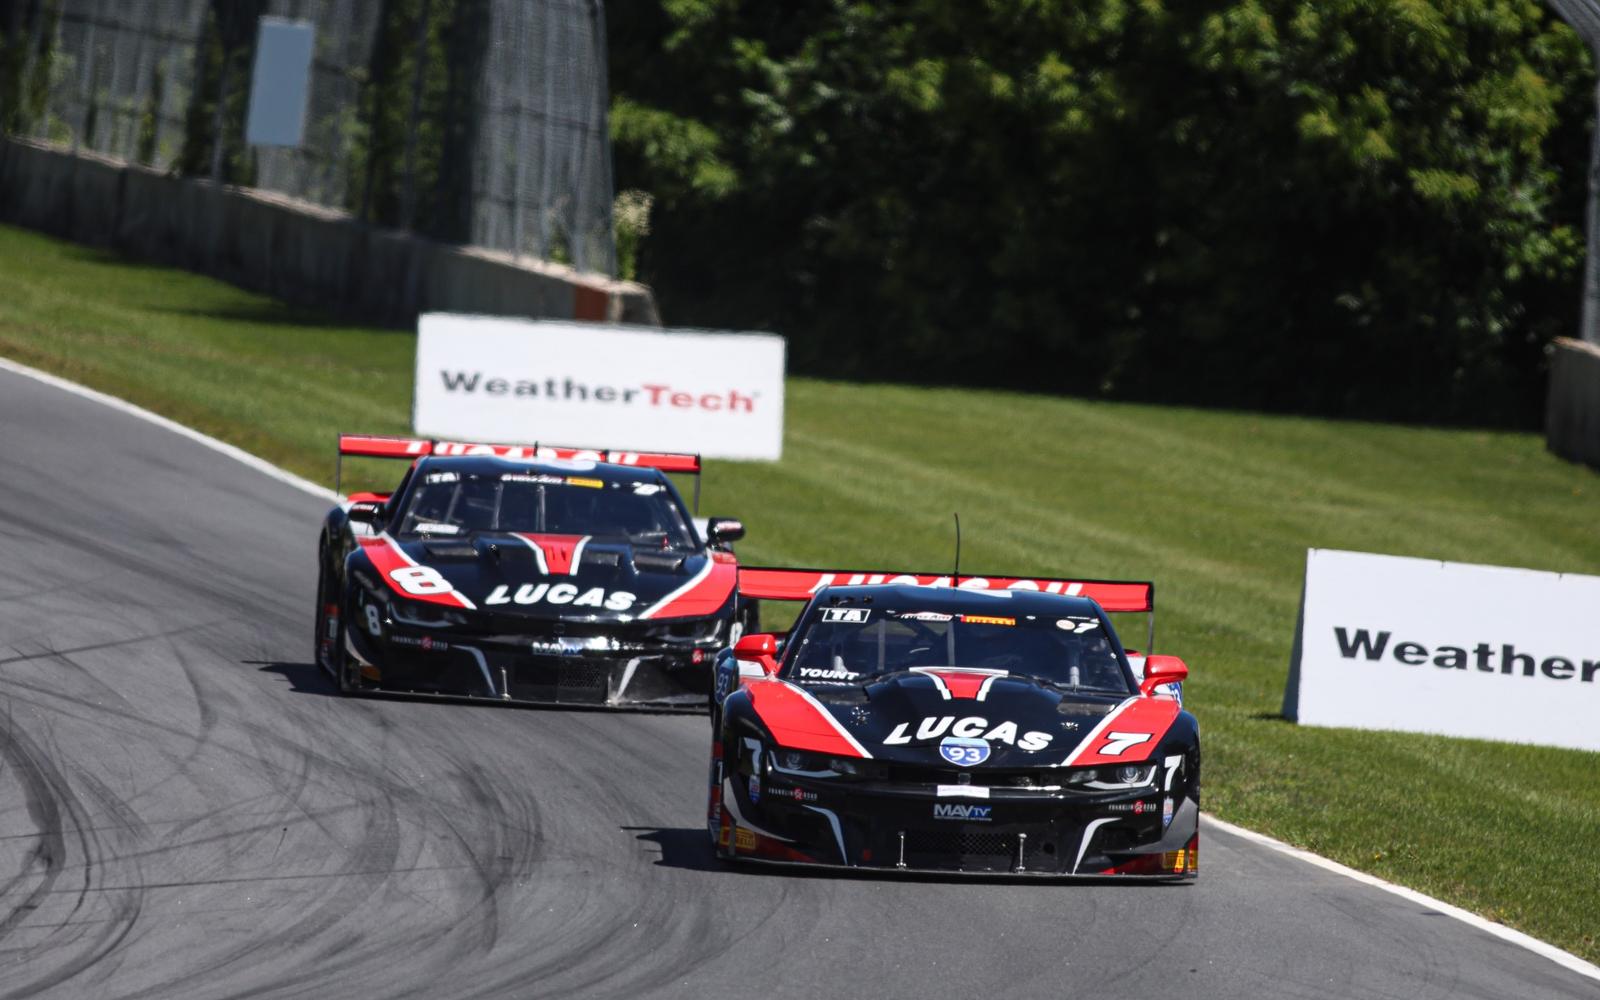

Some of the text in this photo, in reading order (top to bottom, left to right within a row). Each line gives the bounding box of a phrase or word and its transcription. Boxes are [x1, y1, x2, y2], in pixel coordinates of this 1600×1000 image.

[440, 370, 754, 412] WeatherTech
[388, 565, 454, 595] 8
[485, 583, 637, 611] LUCAS
[365, 604, 381, 637] 8
[831, 609, 862, 621] TA
[1073, 622, 1099, 634] 7
[1333, 626, 1600, 682] Weather
[800, 667, 860, 680] YOUNT
[883, 716, 1053, 751] LUCAS
[1098, 731, 1152, 756] 7
[743, 736, 762, 775] 7
[1164, 754, 1182, 791] 7
